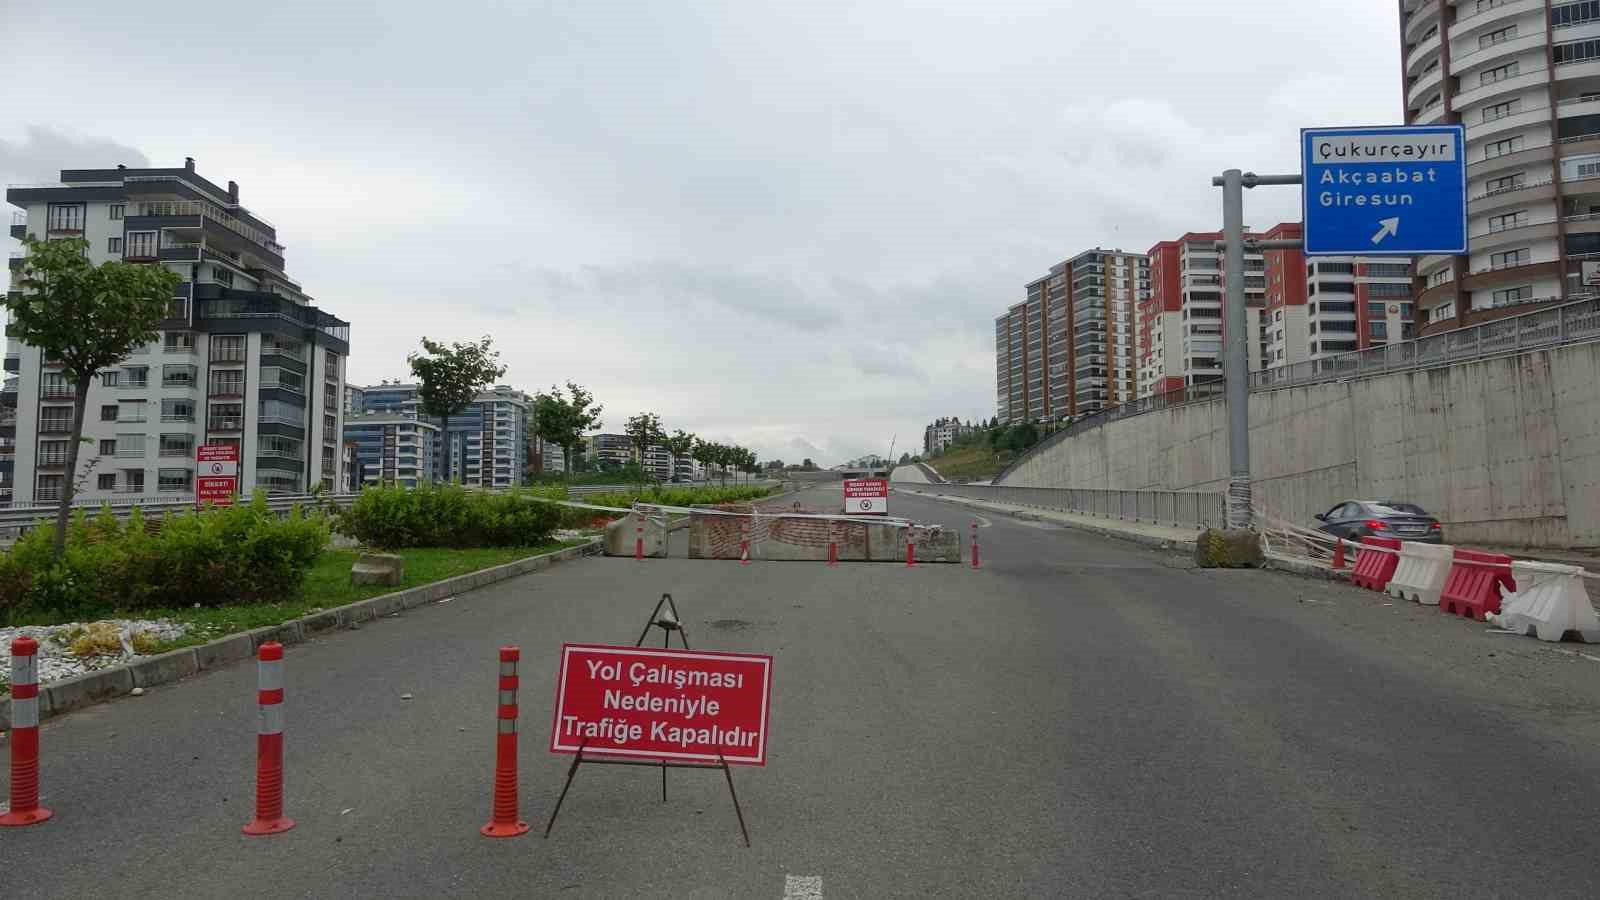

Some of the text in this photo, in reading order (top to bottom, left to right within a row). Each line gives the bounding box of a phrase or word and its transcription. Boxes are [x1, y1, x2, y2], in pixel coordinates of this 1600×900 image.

[1319, 142, 1448, 159] Çukurçayır
[1320, 168, 1437, 185] Akçaabat
[1320, 191, 1413, 206] Giresun
[586, 659, 743, 689] Yol Çalışması
[603, 689, 720, 719] Nedeniyle
[563, 716, 758, 748] Trafiğe Kapalıdır
